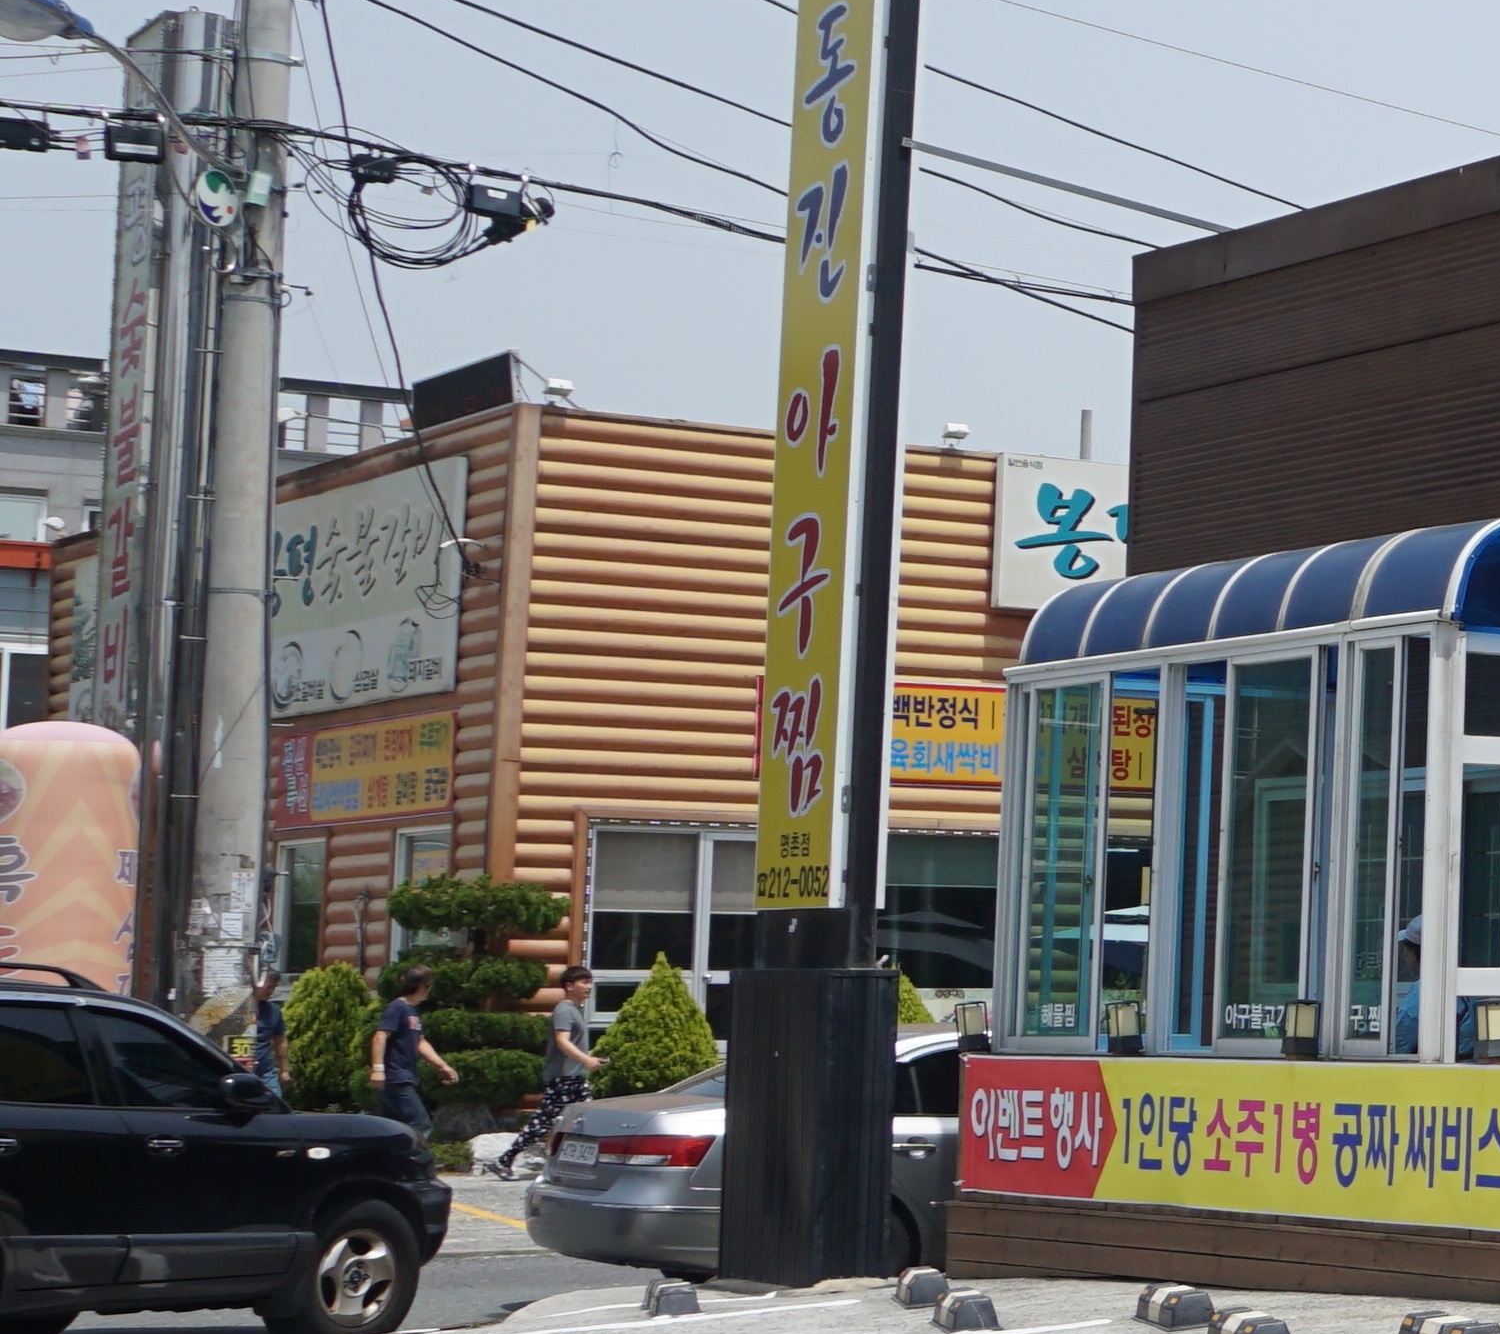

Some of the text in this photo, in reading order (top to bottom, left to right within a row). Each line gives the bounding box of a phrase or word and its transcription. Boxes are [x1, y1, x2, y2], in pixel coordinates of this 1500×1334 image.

[770, 343, 842, 819] 아구찜
[890, 738, 1000, 776] 육회새싹비
[779, 830, 811, 859] 명촌점
[767, 864, 829, 899] 212-0052
[970, 1085, 1104, 1170] 이벤트 행사
[1122, 1092, 1198, 1176] 1인당
[1203, 1097, 1322, 1186] 소주1병
